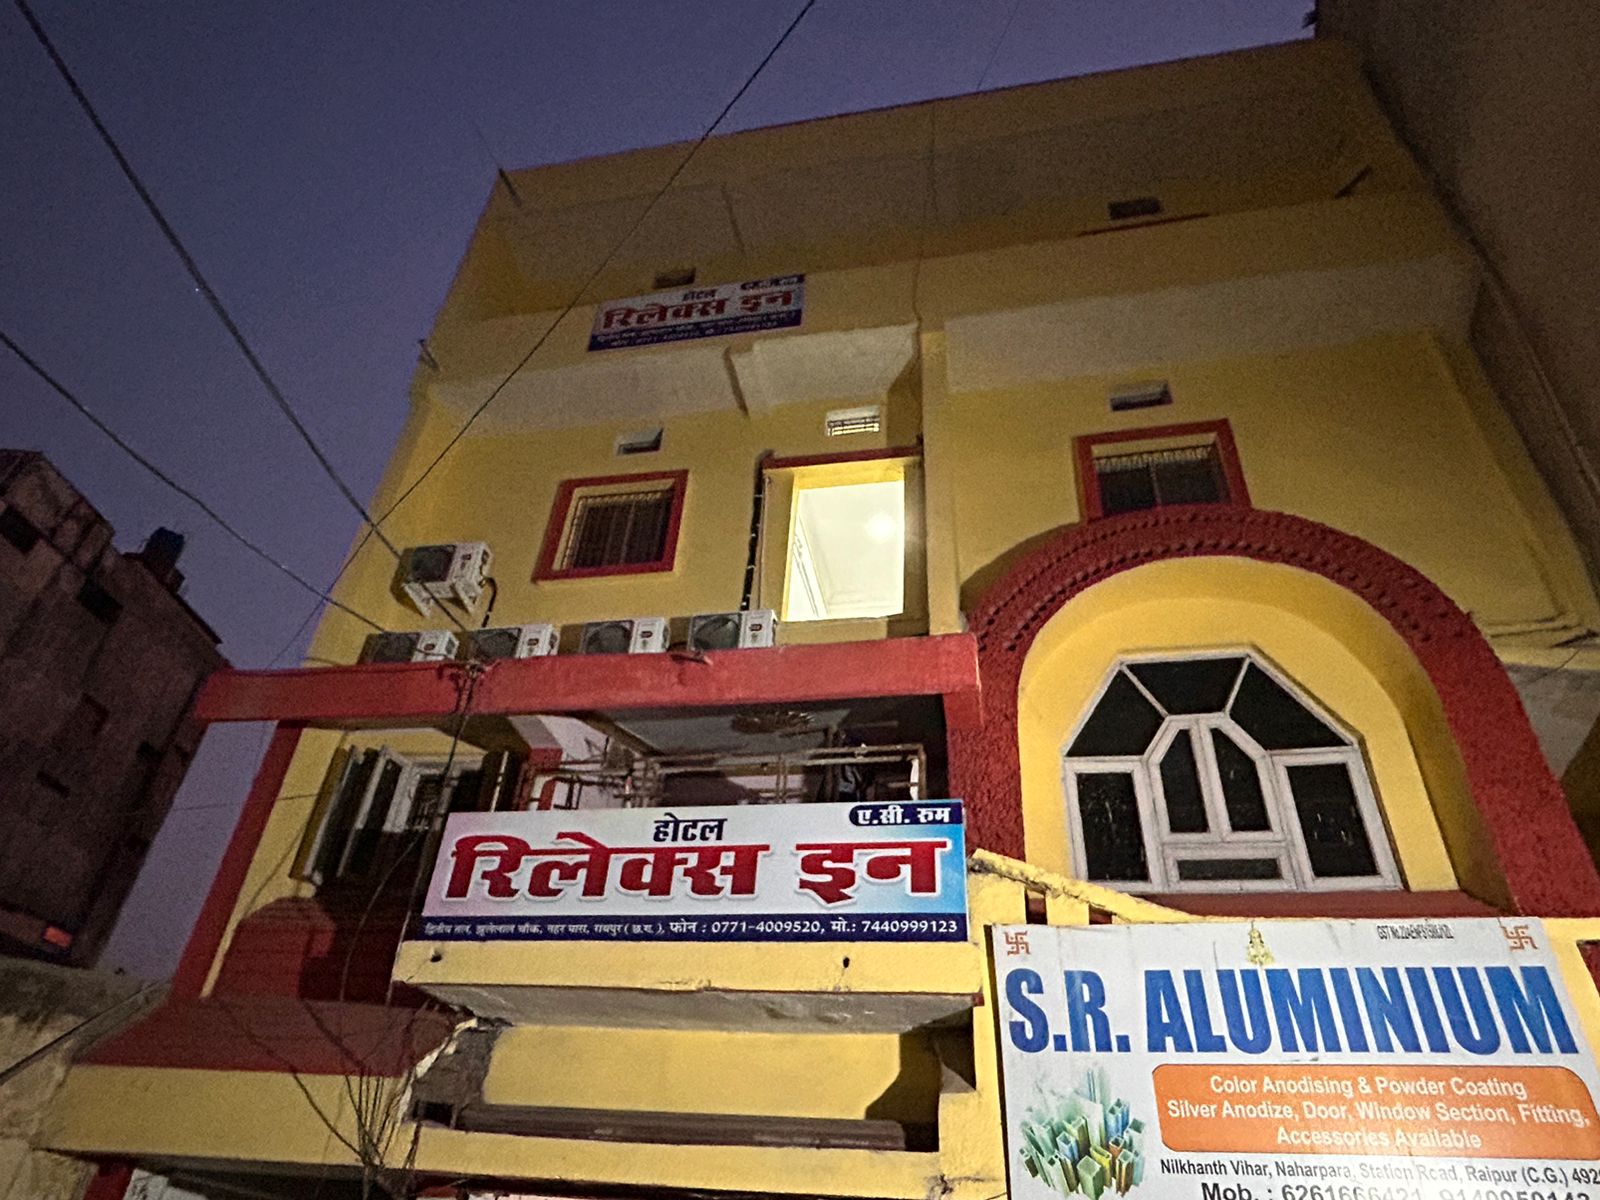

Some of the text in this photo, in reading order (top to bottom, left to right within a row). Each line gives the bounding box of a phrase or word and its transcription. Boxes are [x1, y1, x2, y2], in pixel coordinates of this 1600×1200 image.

[653, 812, 728, 843] होटल
[857, 804, 910, 824] ए.सी.
[446, 831, 948, 904] रिलेक्स इन
[670, 920, 697, 934] फोन
[711, 919, 826, 935] 0771-4009520,
[861, 919, 958, 933] 7440999123
[1005, 966, 1580, 1055] S.R. ALUMINIUM
[1210, 1075, 1527, 1100] Color Anodising & Powder Coating
[1167, 1100, 1590, 1128] Silver Anodize, Door, Window Section, Fitting,
[1277, 1126, 1482, 1149] Accessories Available
[1160, 1159, 1227, 1176] Nilkhanth
[1229, 1160, 1272, 1178] Vihar,
[1361, 1163, 1412, 1182] Station
[1466, 1165, 1517, 1184] Raipur
[1521, 1166, 1569, 1188] (C.G.)
[1572, 1168, 1600, 1184] 492
